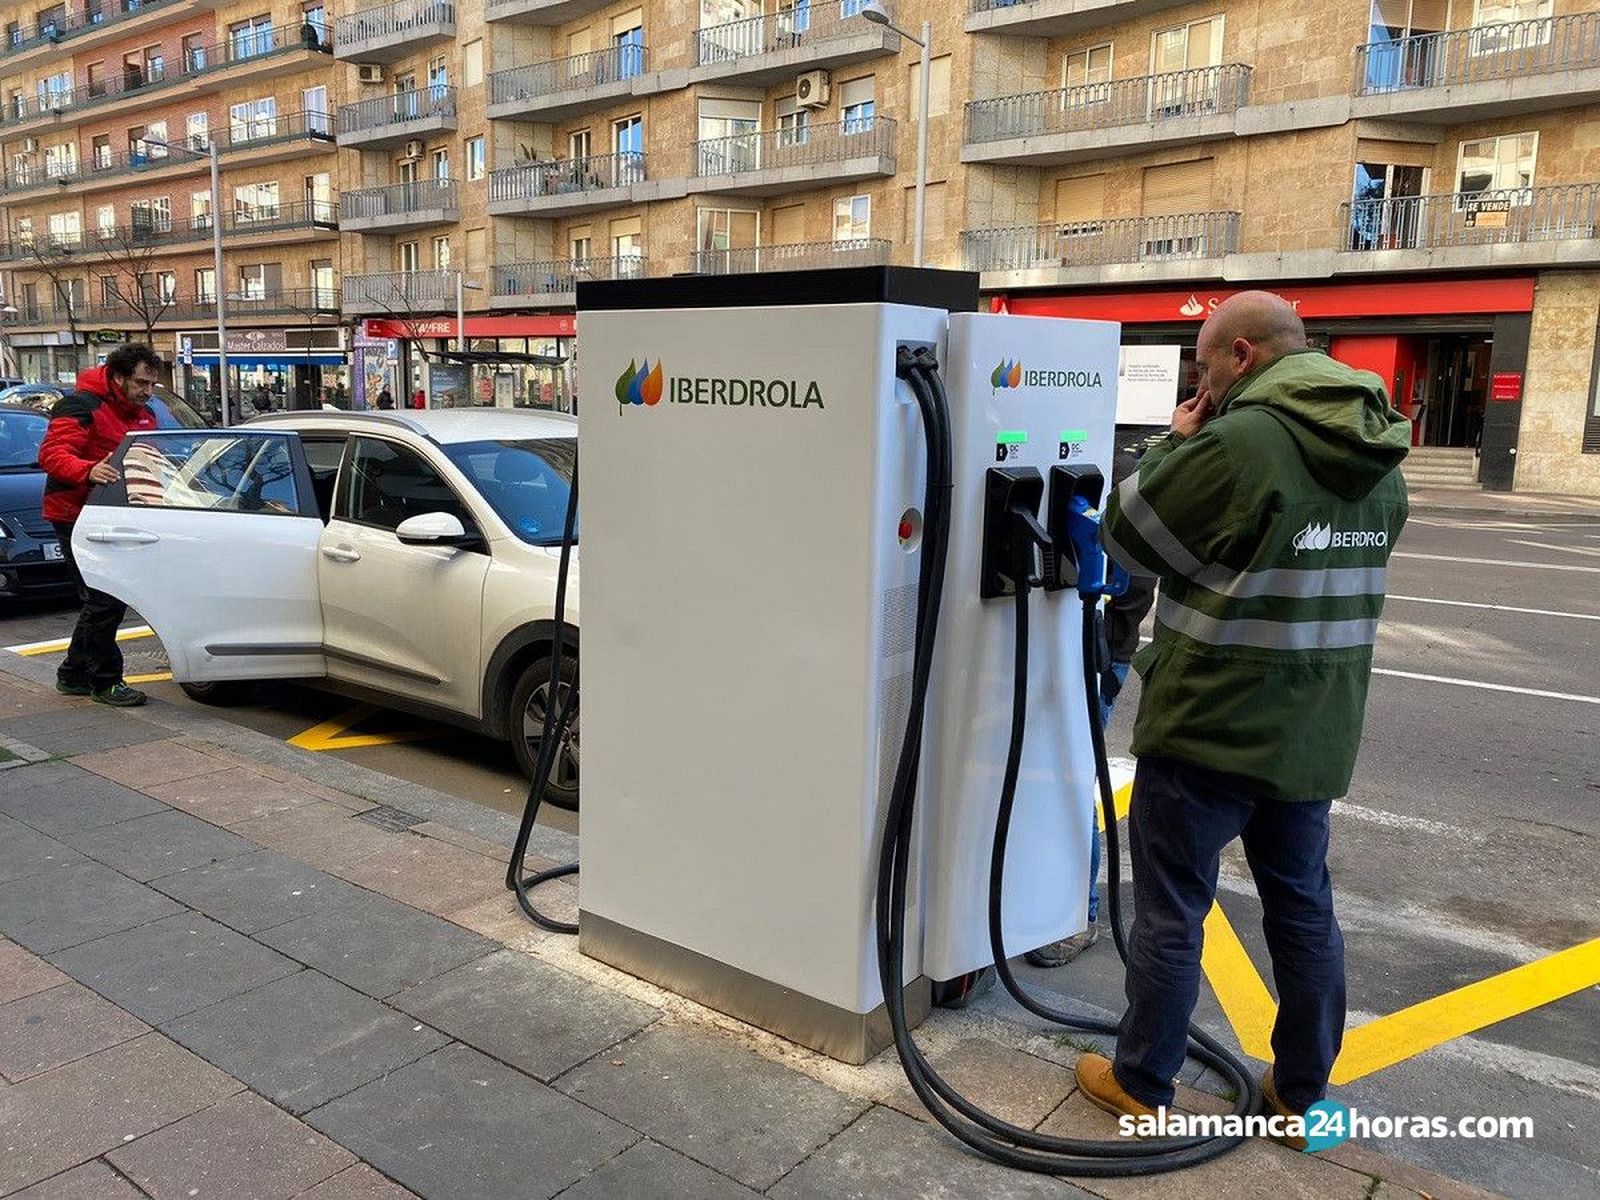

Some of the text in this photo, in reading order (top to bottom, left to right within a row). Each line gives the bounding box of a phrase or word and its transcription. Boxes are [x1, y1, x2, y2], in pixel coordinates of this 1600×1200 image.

[1468, 201, 1510, 211] SE VENDE
[387, 341, 396, 352] P
[1024, 371, 1102, 387] IBERDROLA
[669, 377, 825, 409] IBERDROLA
